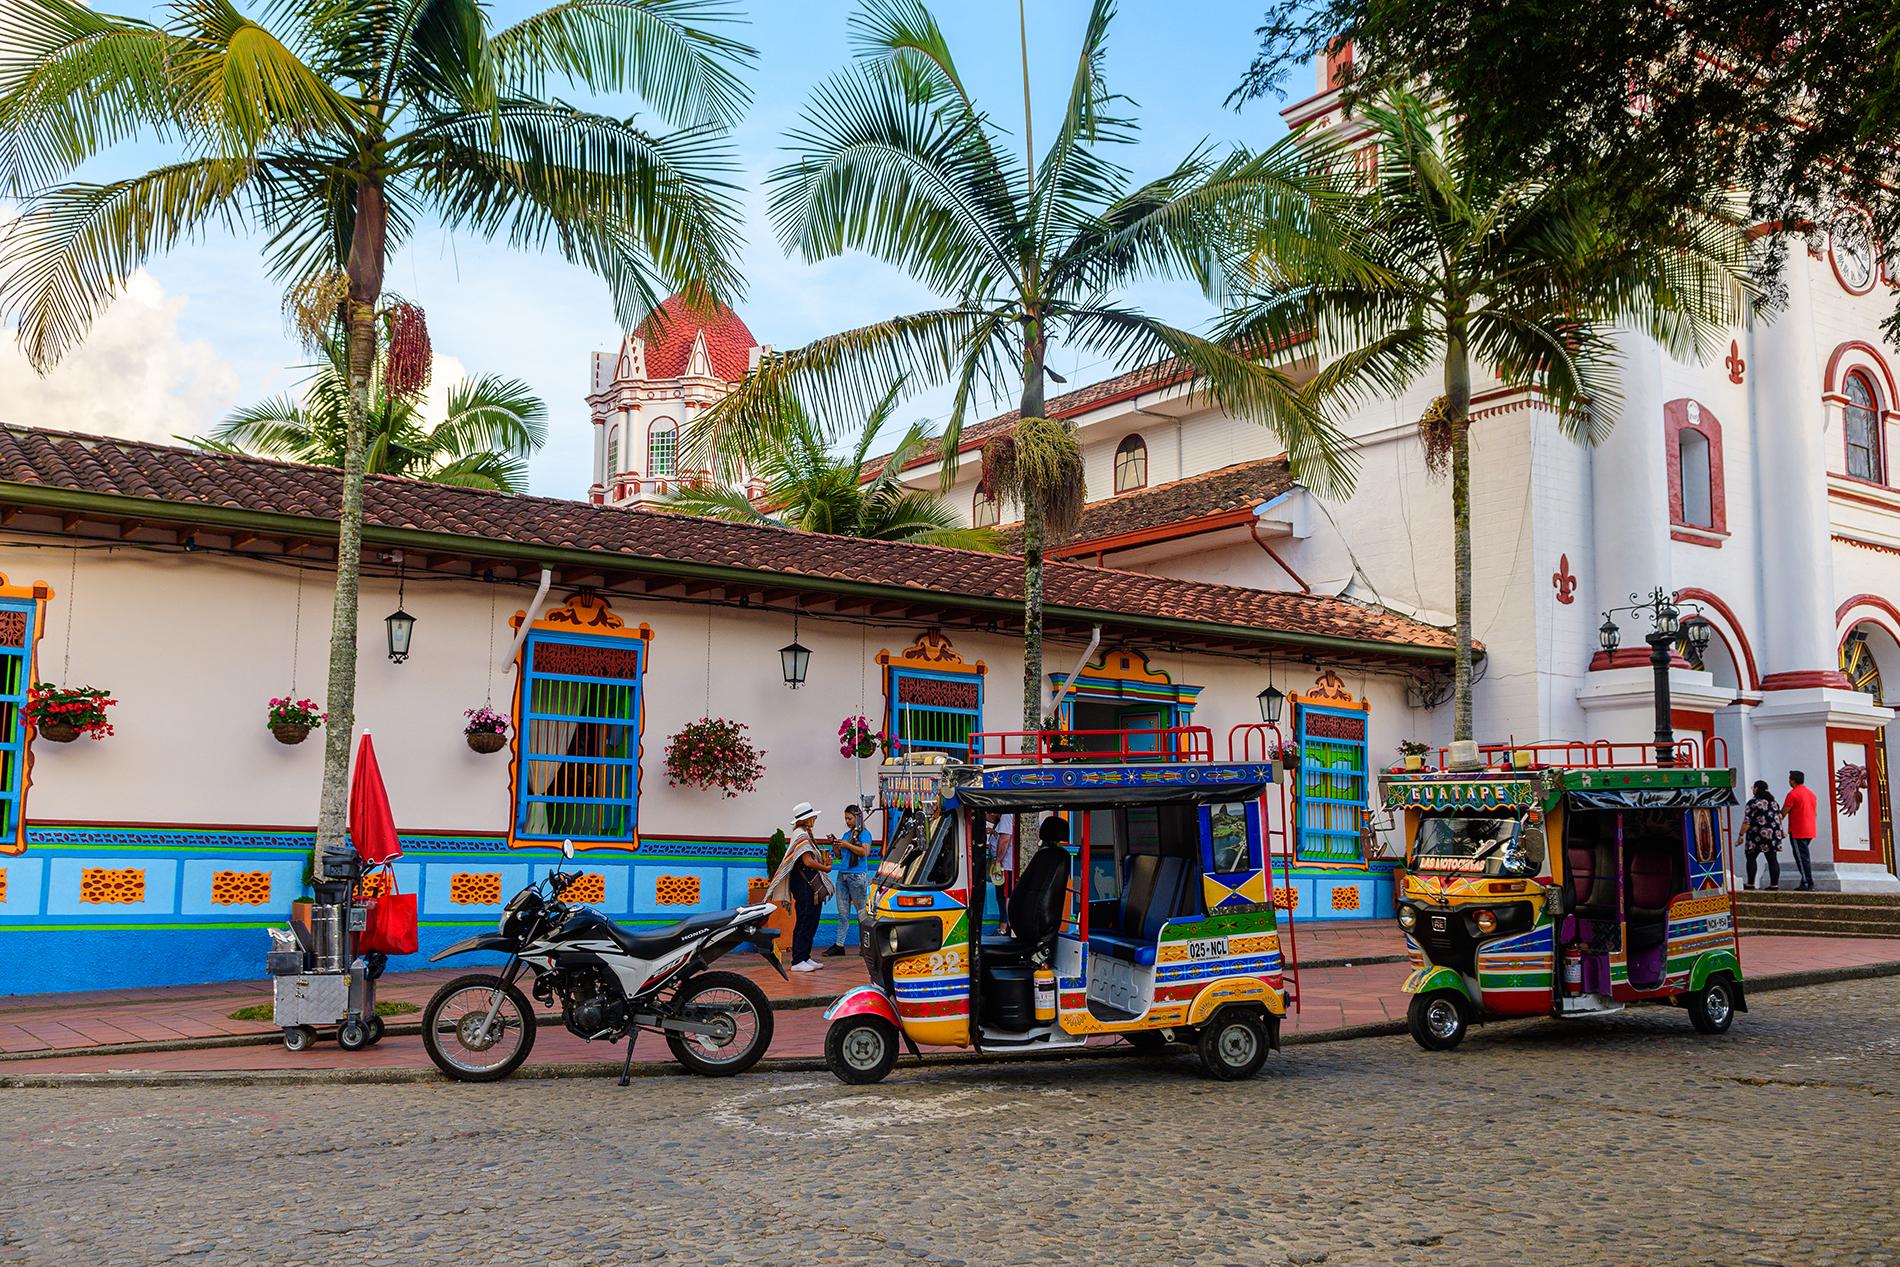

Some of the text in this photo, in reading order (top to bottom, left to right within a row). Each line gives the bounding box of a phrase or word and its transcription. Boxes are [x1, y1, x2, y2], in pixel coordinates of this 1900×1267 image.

[1411, 785, 1505, 801] GUATAPE
[681, 927, 710, 941] HONDA
[1190, 940, 1227, 958] 025-NCL
[930, 951, 960, 974] 22
